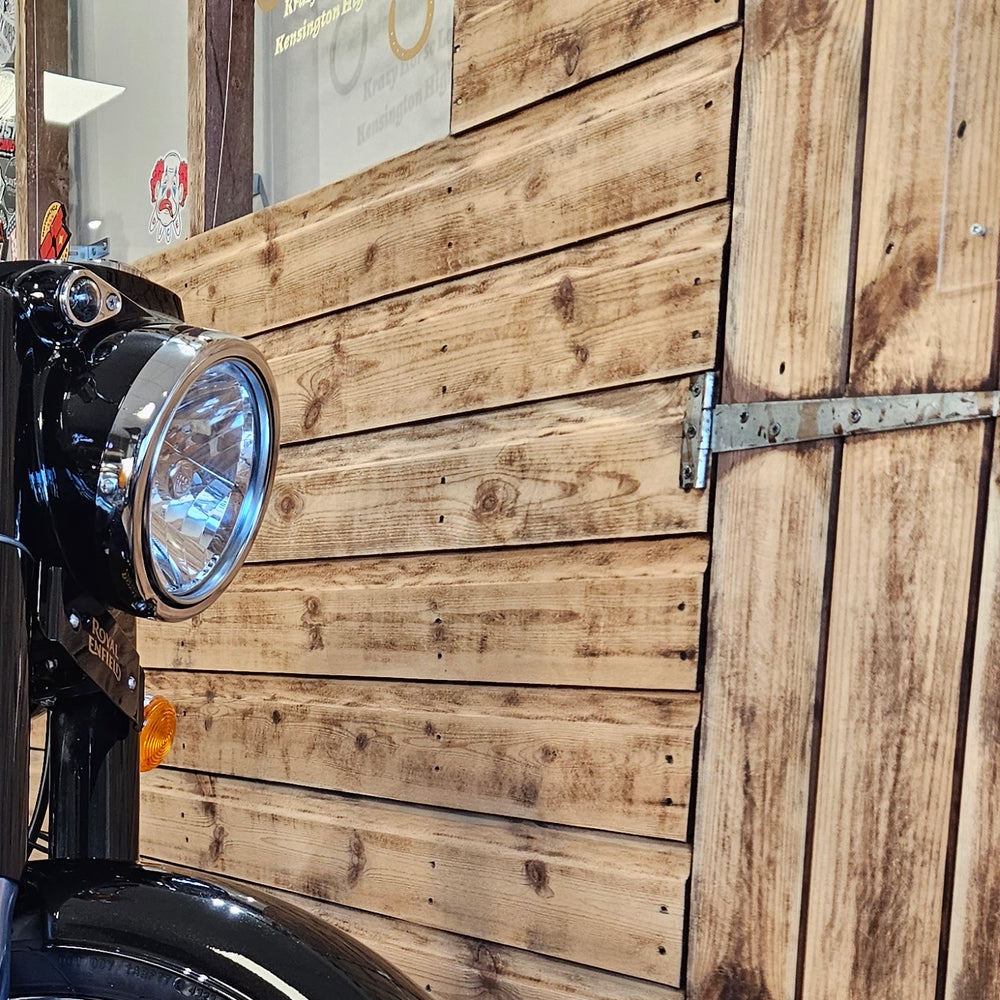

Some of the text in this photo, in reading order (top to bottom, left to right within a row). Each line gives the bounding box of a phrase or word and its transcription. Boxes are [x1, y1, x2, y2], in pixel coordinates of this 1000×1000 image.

[274, 4, 340, 56] Kensington
[88, 634, 122, 682] ENFIELD
[92, 616, 119, 660] ROYAL
